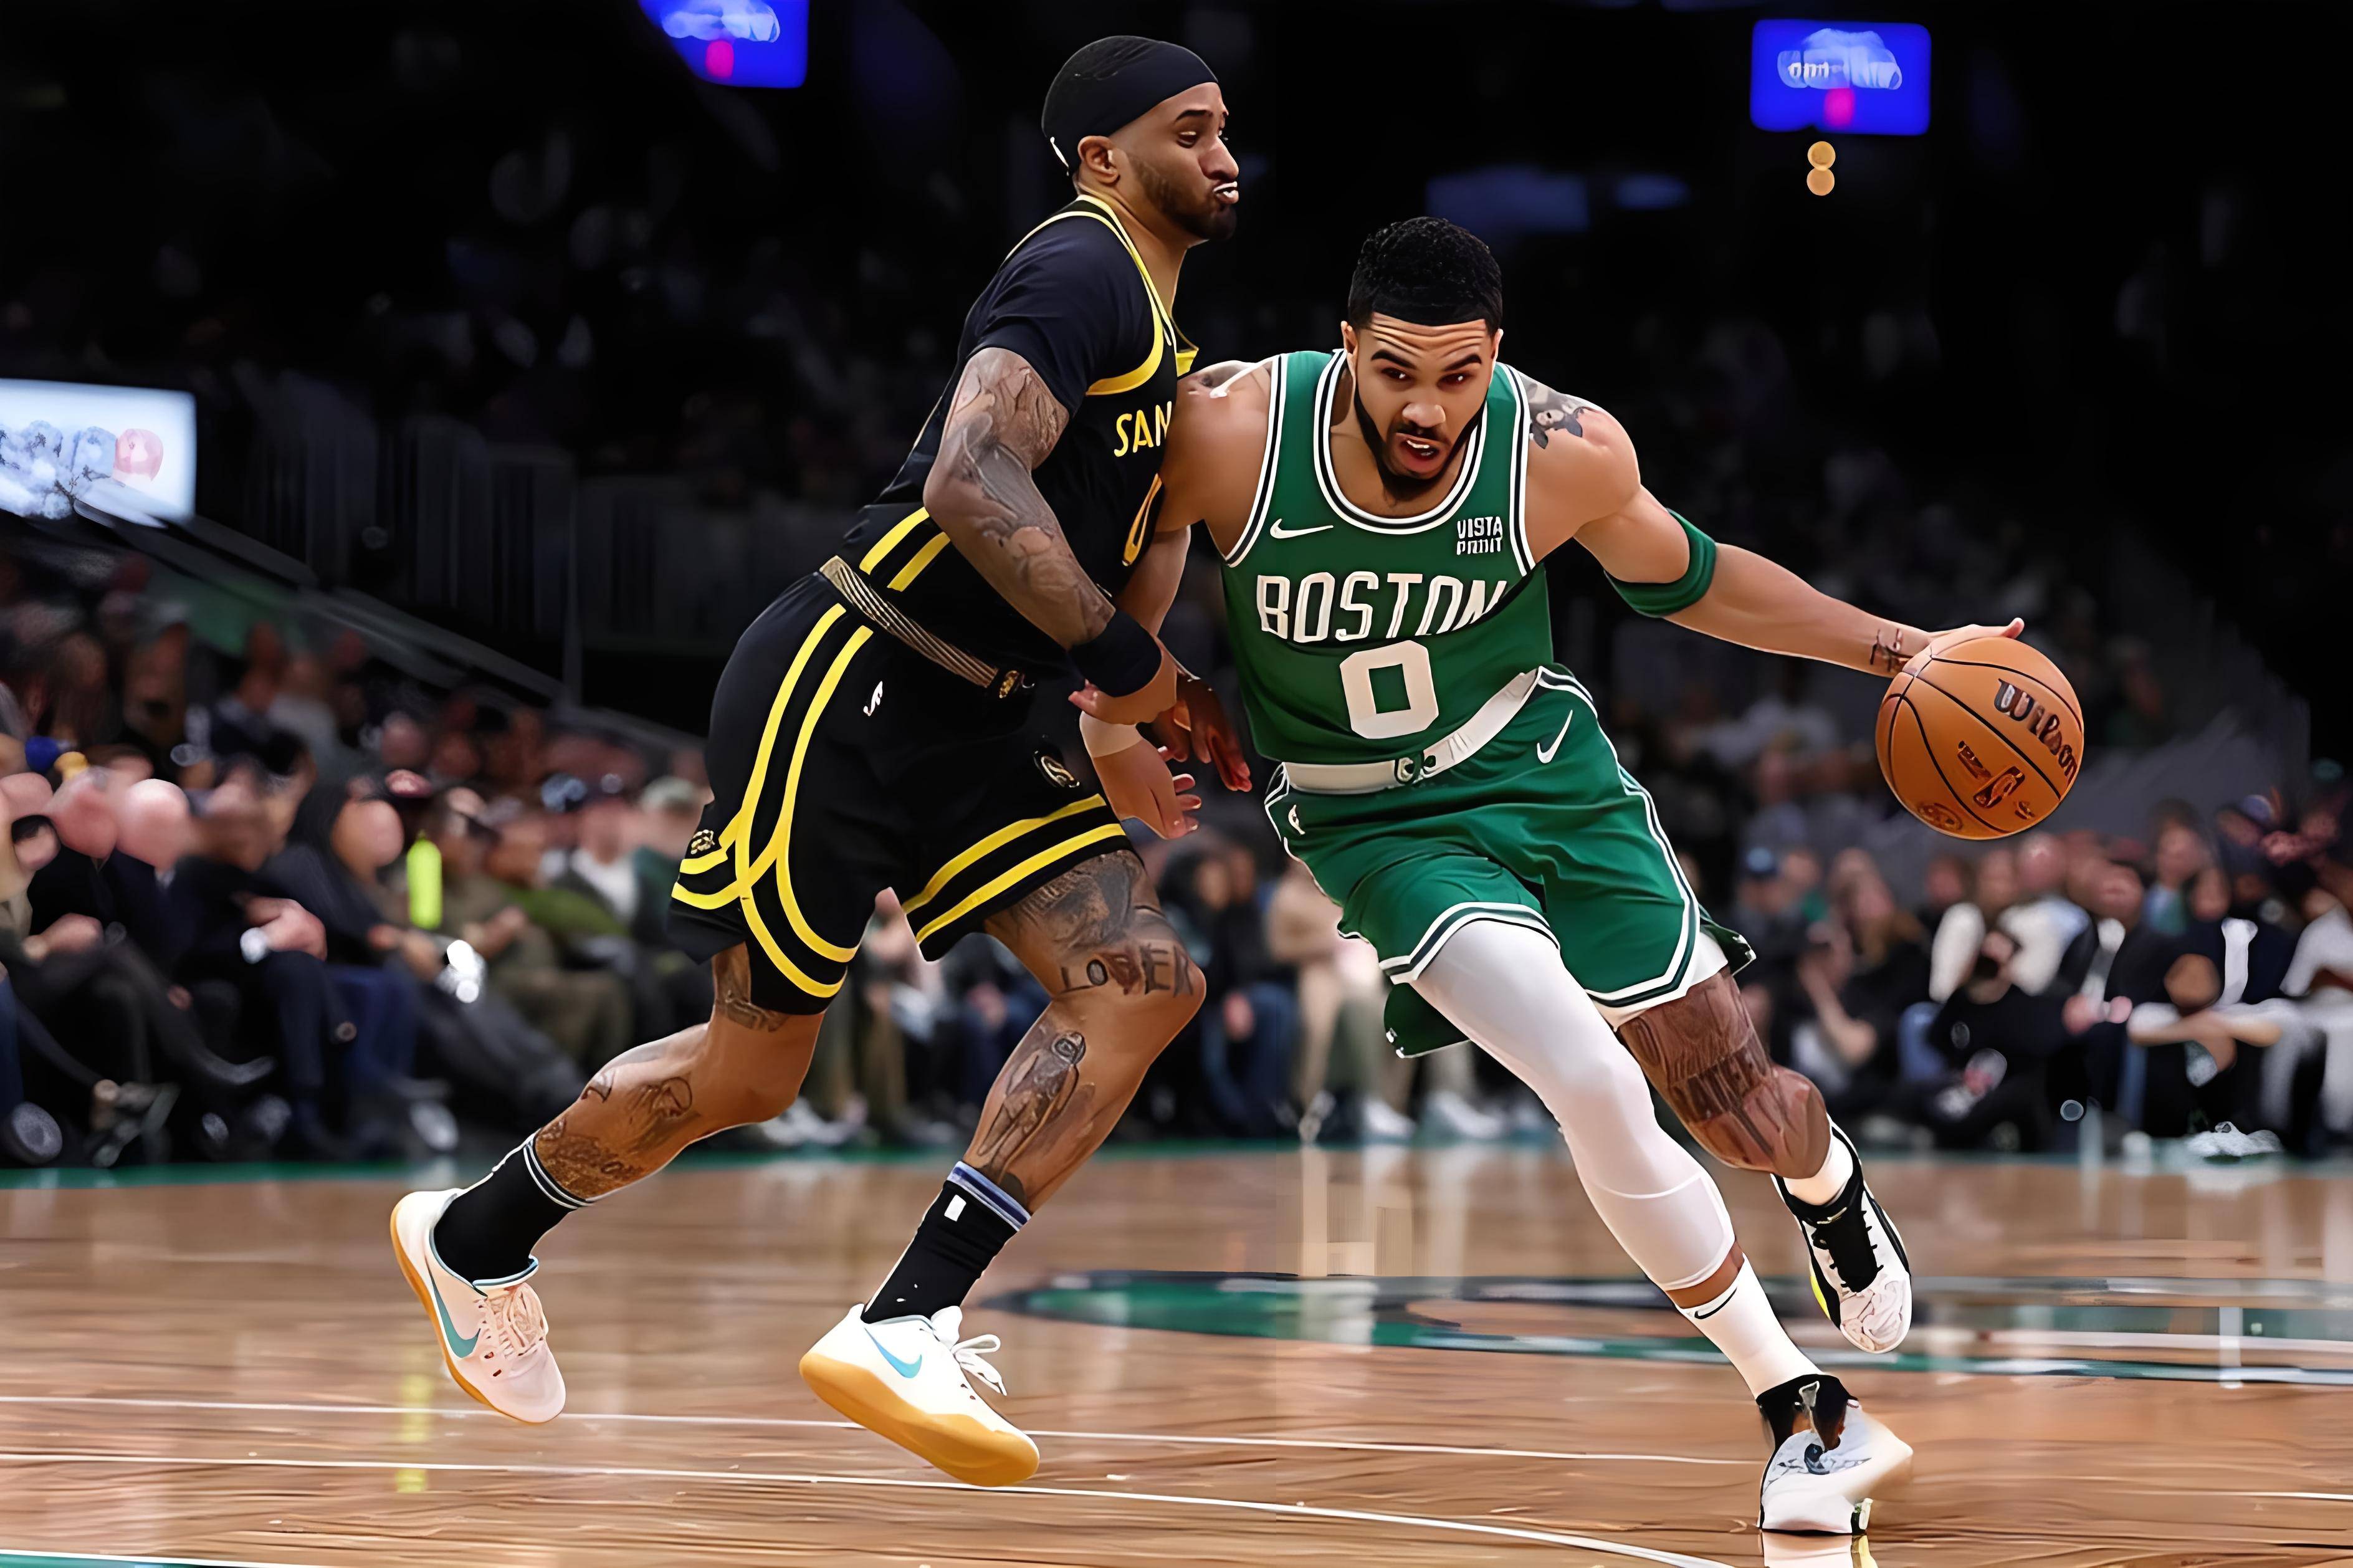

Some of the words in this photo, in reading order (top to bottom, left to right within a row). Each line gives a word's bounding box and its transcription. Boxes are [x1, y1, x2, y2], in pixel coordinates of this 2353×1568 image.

[1457, 516, 1503, 539] VISTA
[1256, 571, 1507, 643] BOSTON
[1339, 639, 1439, 740] 0
